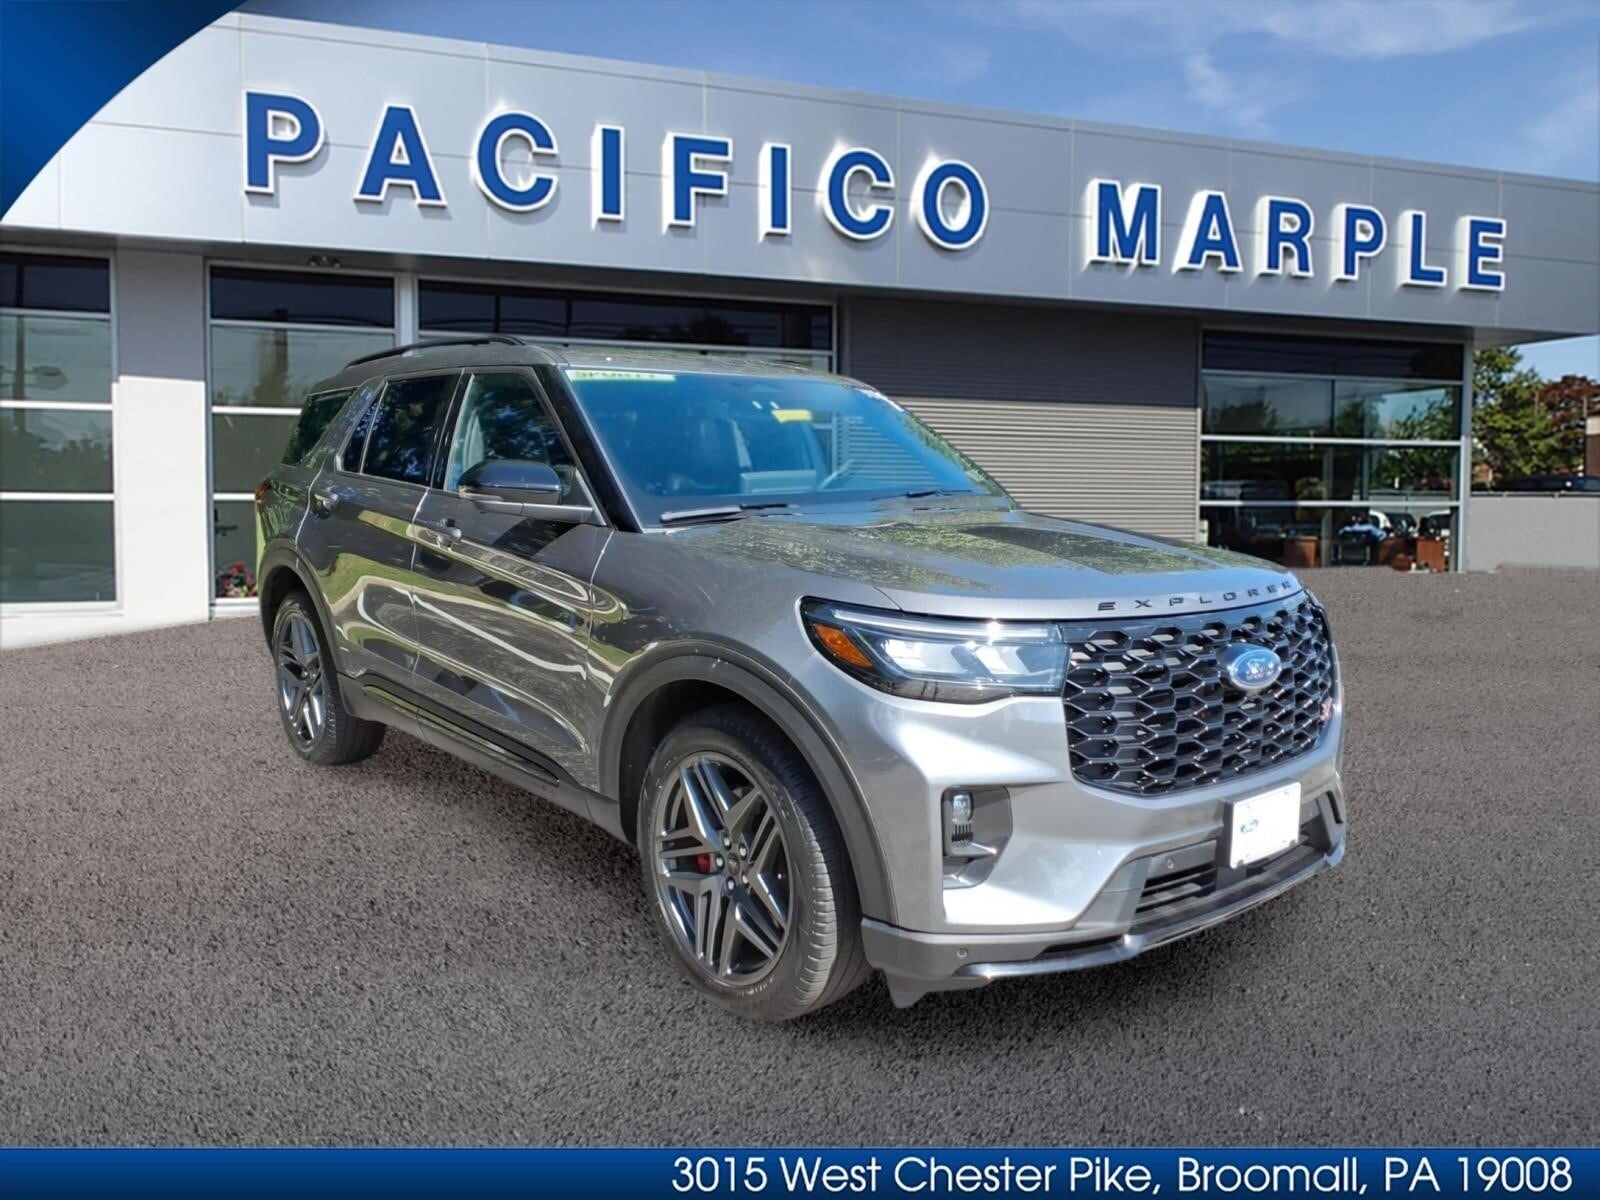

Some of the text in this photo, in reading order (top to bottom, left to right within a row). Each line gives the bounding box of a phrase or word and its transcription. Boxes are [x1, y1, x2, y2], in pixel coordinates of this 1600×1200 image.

[242, 89, 1507, 291] PACIFICO MARPLE
[1097, 581, 1291, 611] EXPLORER
